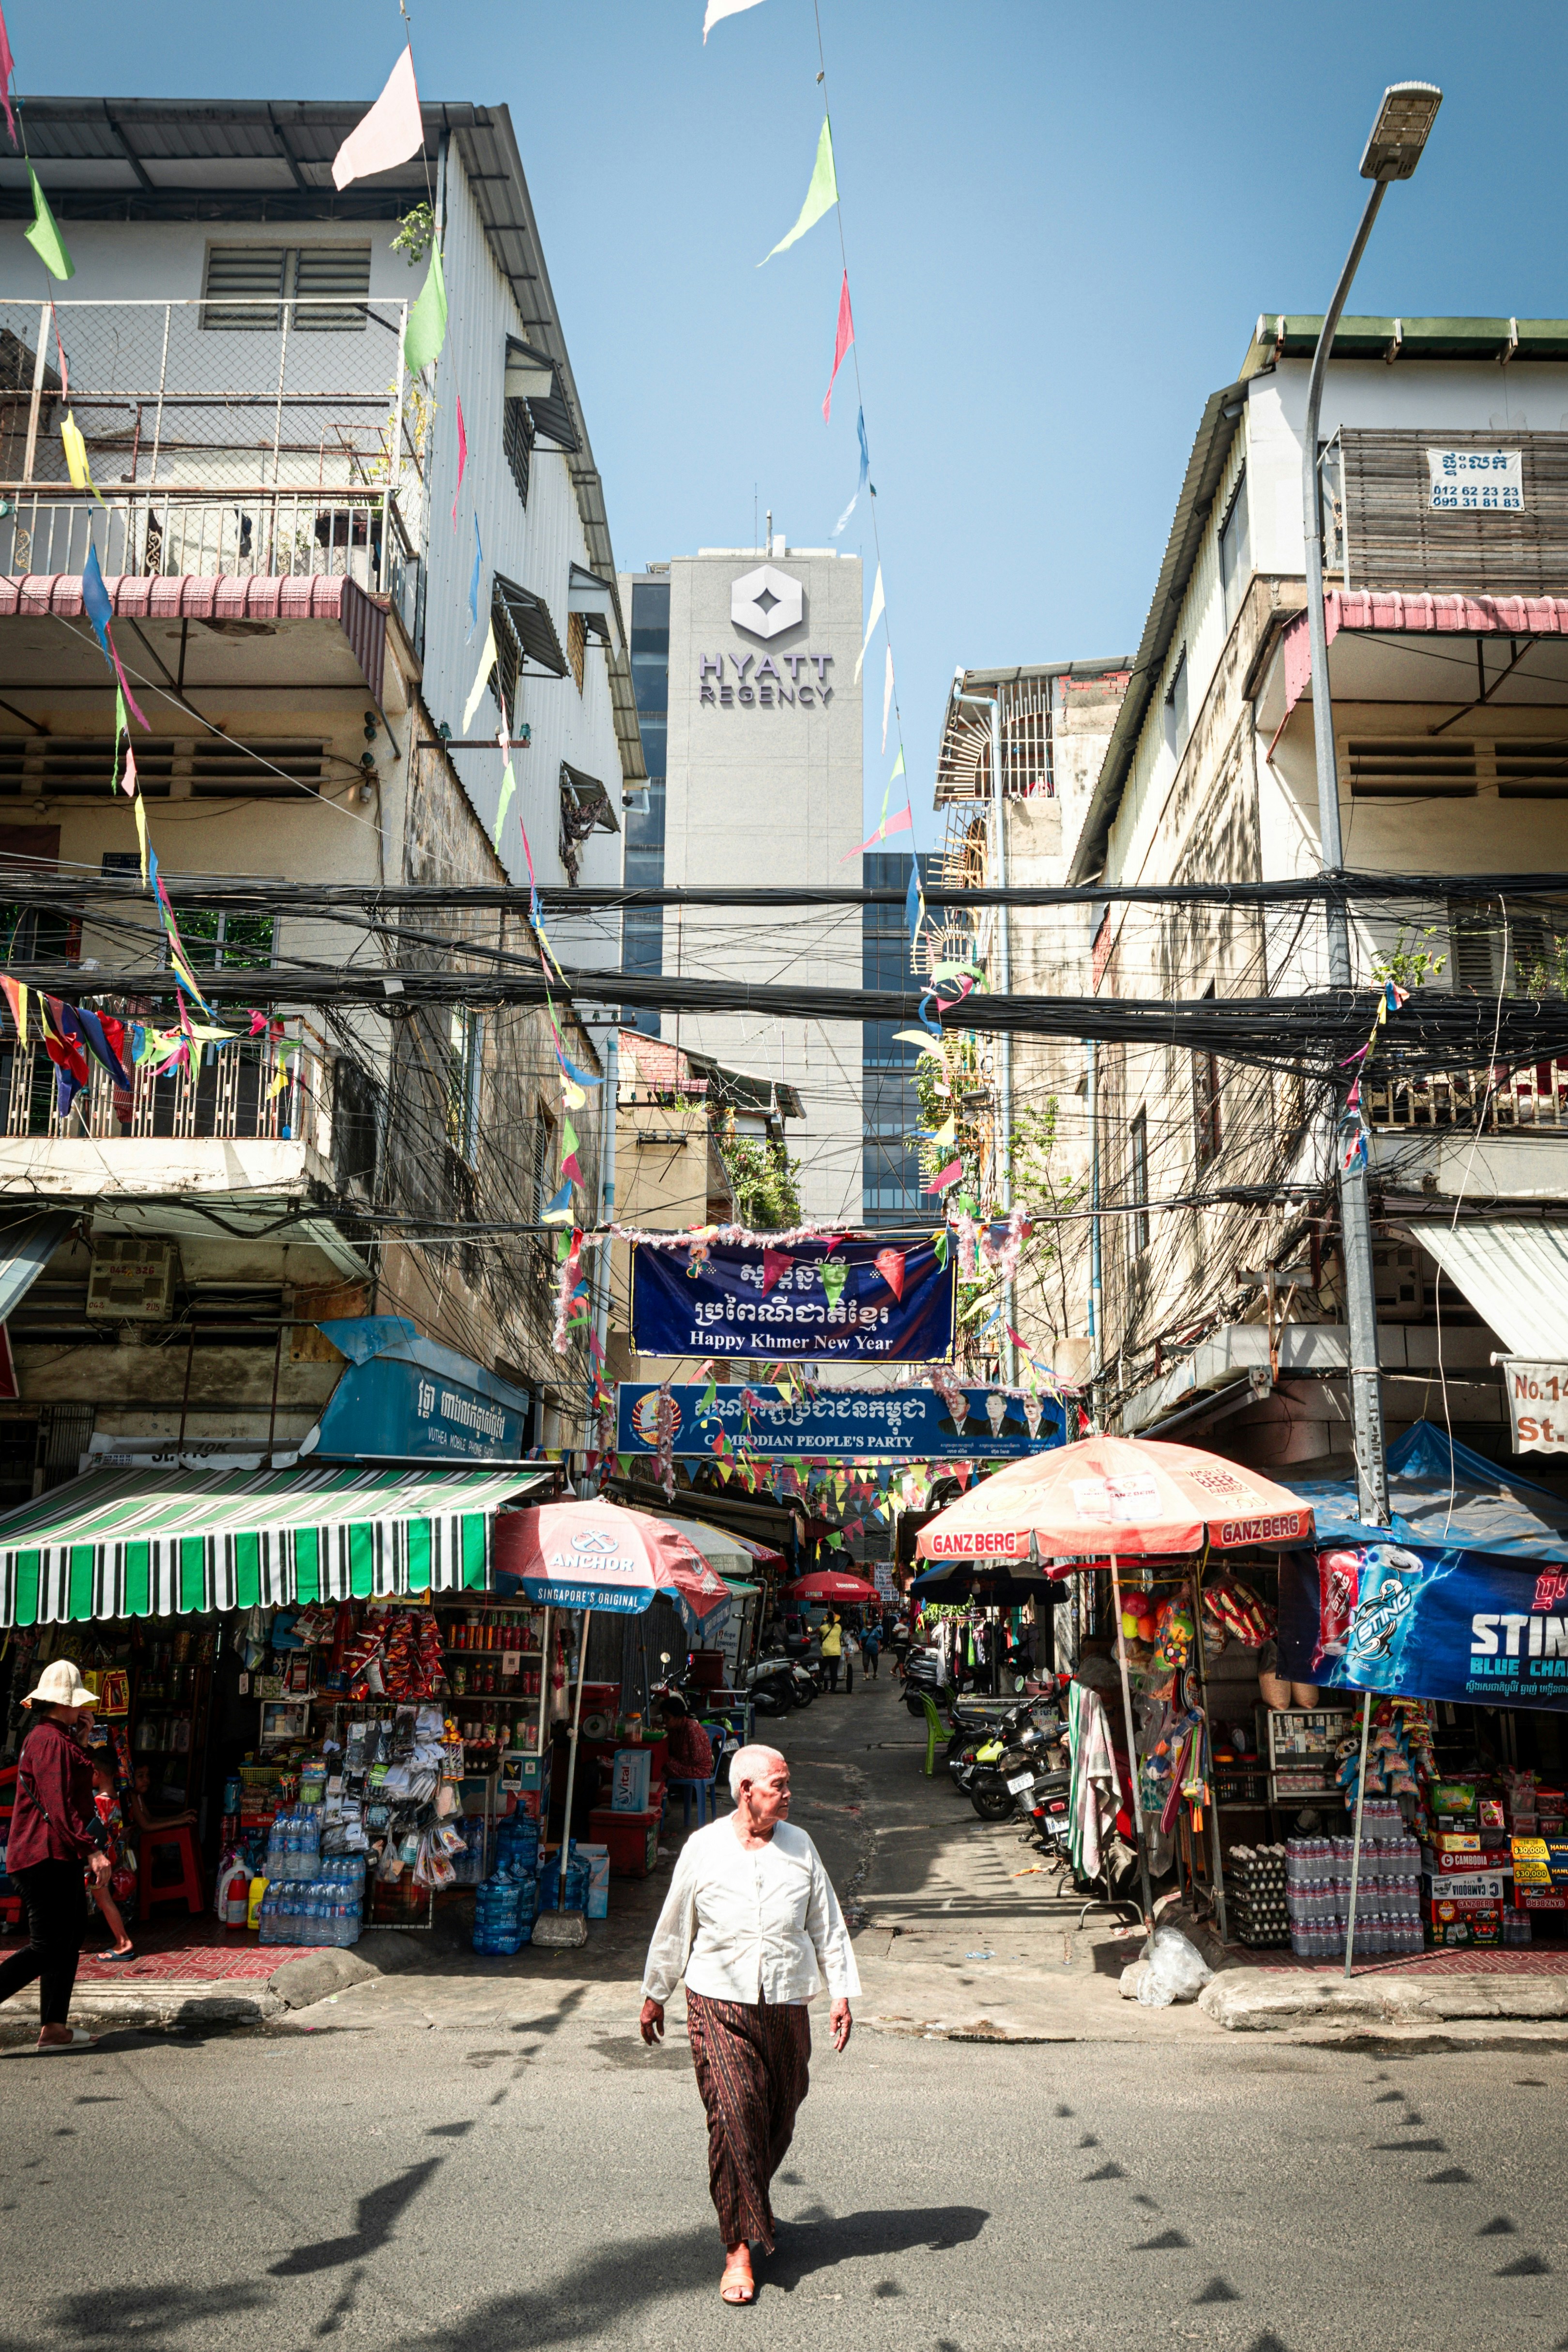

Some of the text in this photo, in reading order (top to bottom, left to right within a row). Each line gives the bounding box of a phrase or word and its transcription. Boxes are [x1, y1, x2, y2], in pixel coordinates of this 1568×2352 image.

[1434, 486, 1518, 496] 012 62 23 23
[1433, 497, 1520, 507] 099 31 81 83
[700, 653, 832, 678] HYATT
[699, 684, 832, 703] REGENCY
[689, 1331, 893, 1350] Happy Khmer New Year
[1518, 1417, 1565, 1442] St.
[428, 1426, 494, 1458] VUTHEA MOBILE PHONE SHOP
[704, 1434, 914, 1448] CMBODIAN PEOPLE'S PARTY
[1186, 1469, 1226, 1478] WORLD
[1195, 1475, 1239, 1487] BEER
[1110, 1490, 1155, 1498] GANZBERG
[1209, 1484, 1248, 1494] AWARDS
[1222, 1514, 1299, 1544] GANZBERG
[932, 1531, 1016, 1554] GANZBERG
[550, 1553, 634, 1572] ANCHOR
[538, 1588, 638, 1607] SINGAPORE'S ORIGINAL
[1331, 1574, 1350, 1612] STING
[1357, 1587, 1411, 1645] STING
[1470, 1657, 1568, 1677] BLUE CHA
[618, 1767, 629, 1794] Vital
[1514, 1847, 1545, 1855] $30,000
[1455, 1854, 1487, 1865] CAMBODIA
[1515, 1870, 1547, 1879] $30,000
[1453, 1884, 1486, 1895] CAMBODIA
[1457, 1899, 1494, 1908] GANZBERG
[1526, 1899, 1566, 1908] GANZBERG
